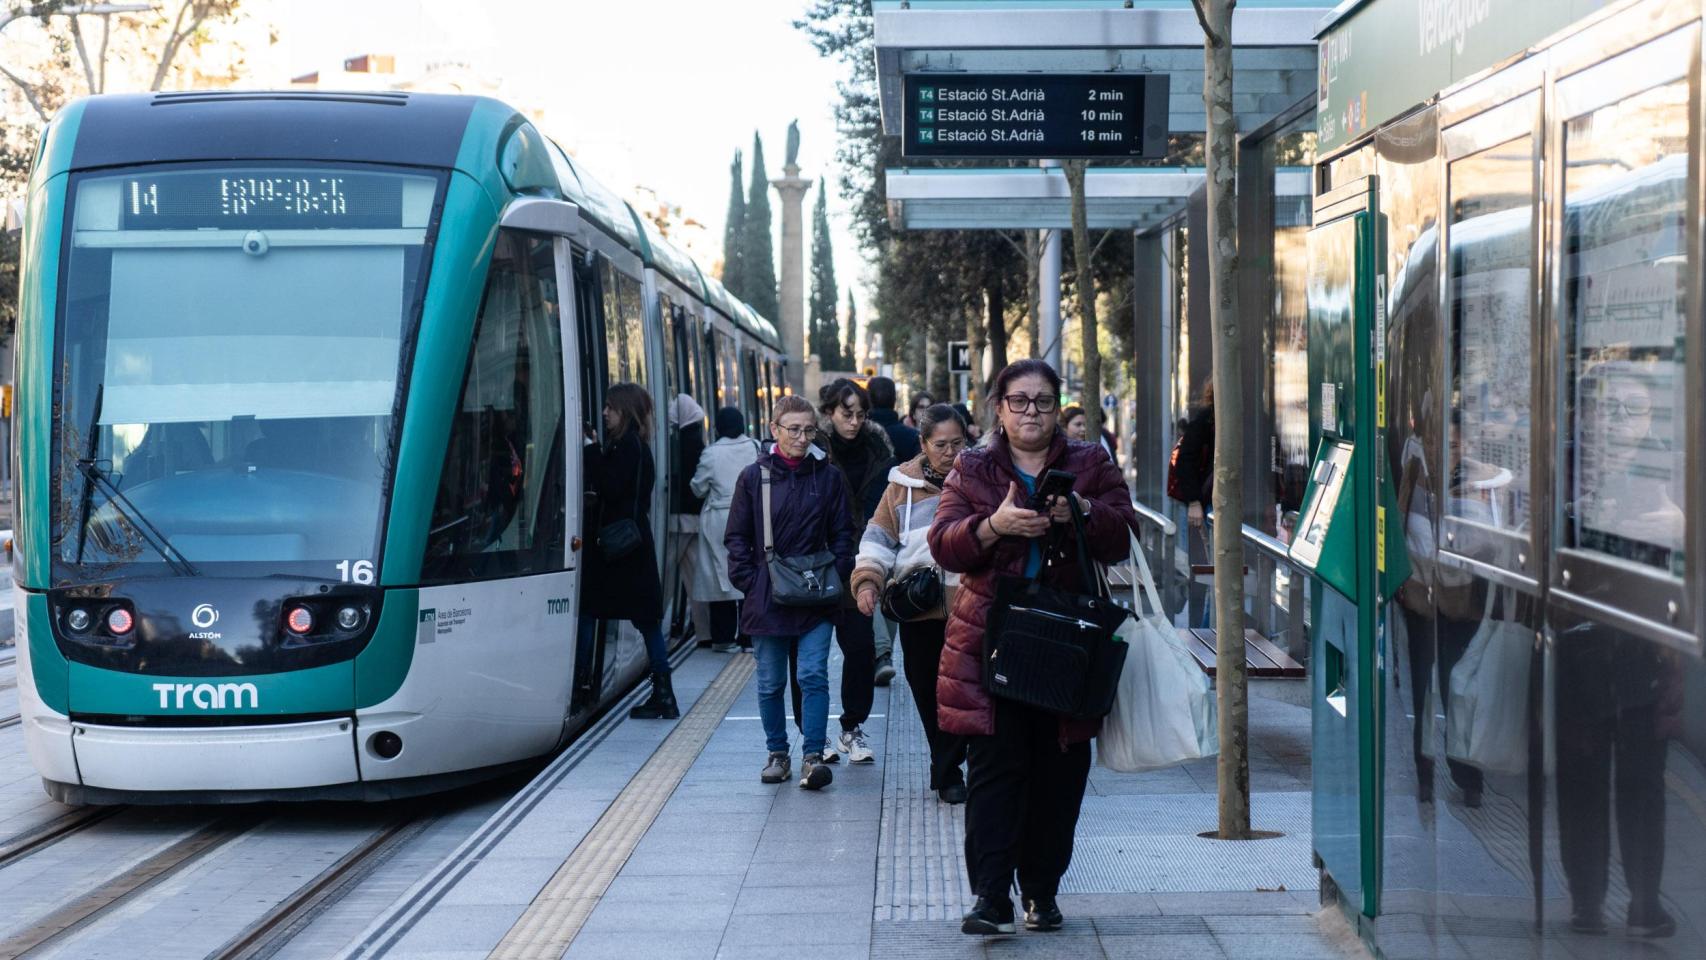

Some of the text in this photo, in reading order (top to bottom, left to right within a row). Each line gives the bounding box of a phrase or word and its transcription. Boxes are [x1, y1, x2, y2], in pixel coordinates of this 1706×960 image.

[920, 88, 1045, 101] T4 Estació St.Adrià
[1088, 89, 1123, 101] 2 min
[920, 108, 1045, 121] T4 Estació St.Adrià
[1081, 110, 1123, 121] 10 min
[920, 129, 1044, 141] T4 Estació St.Adrià
[1080, 130, 1122, 141] 18 min
[335, 559, 374, 586] 16
